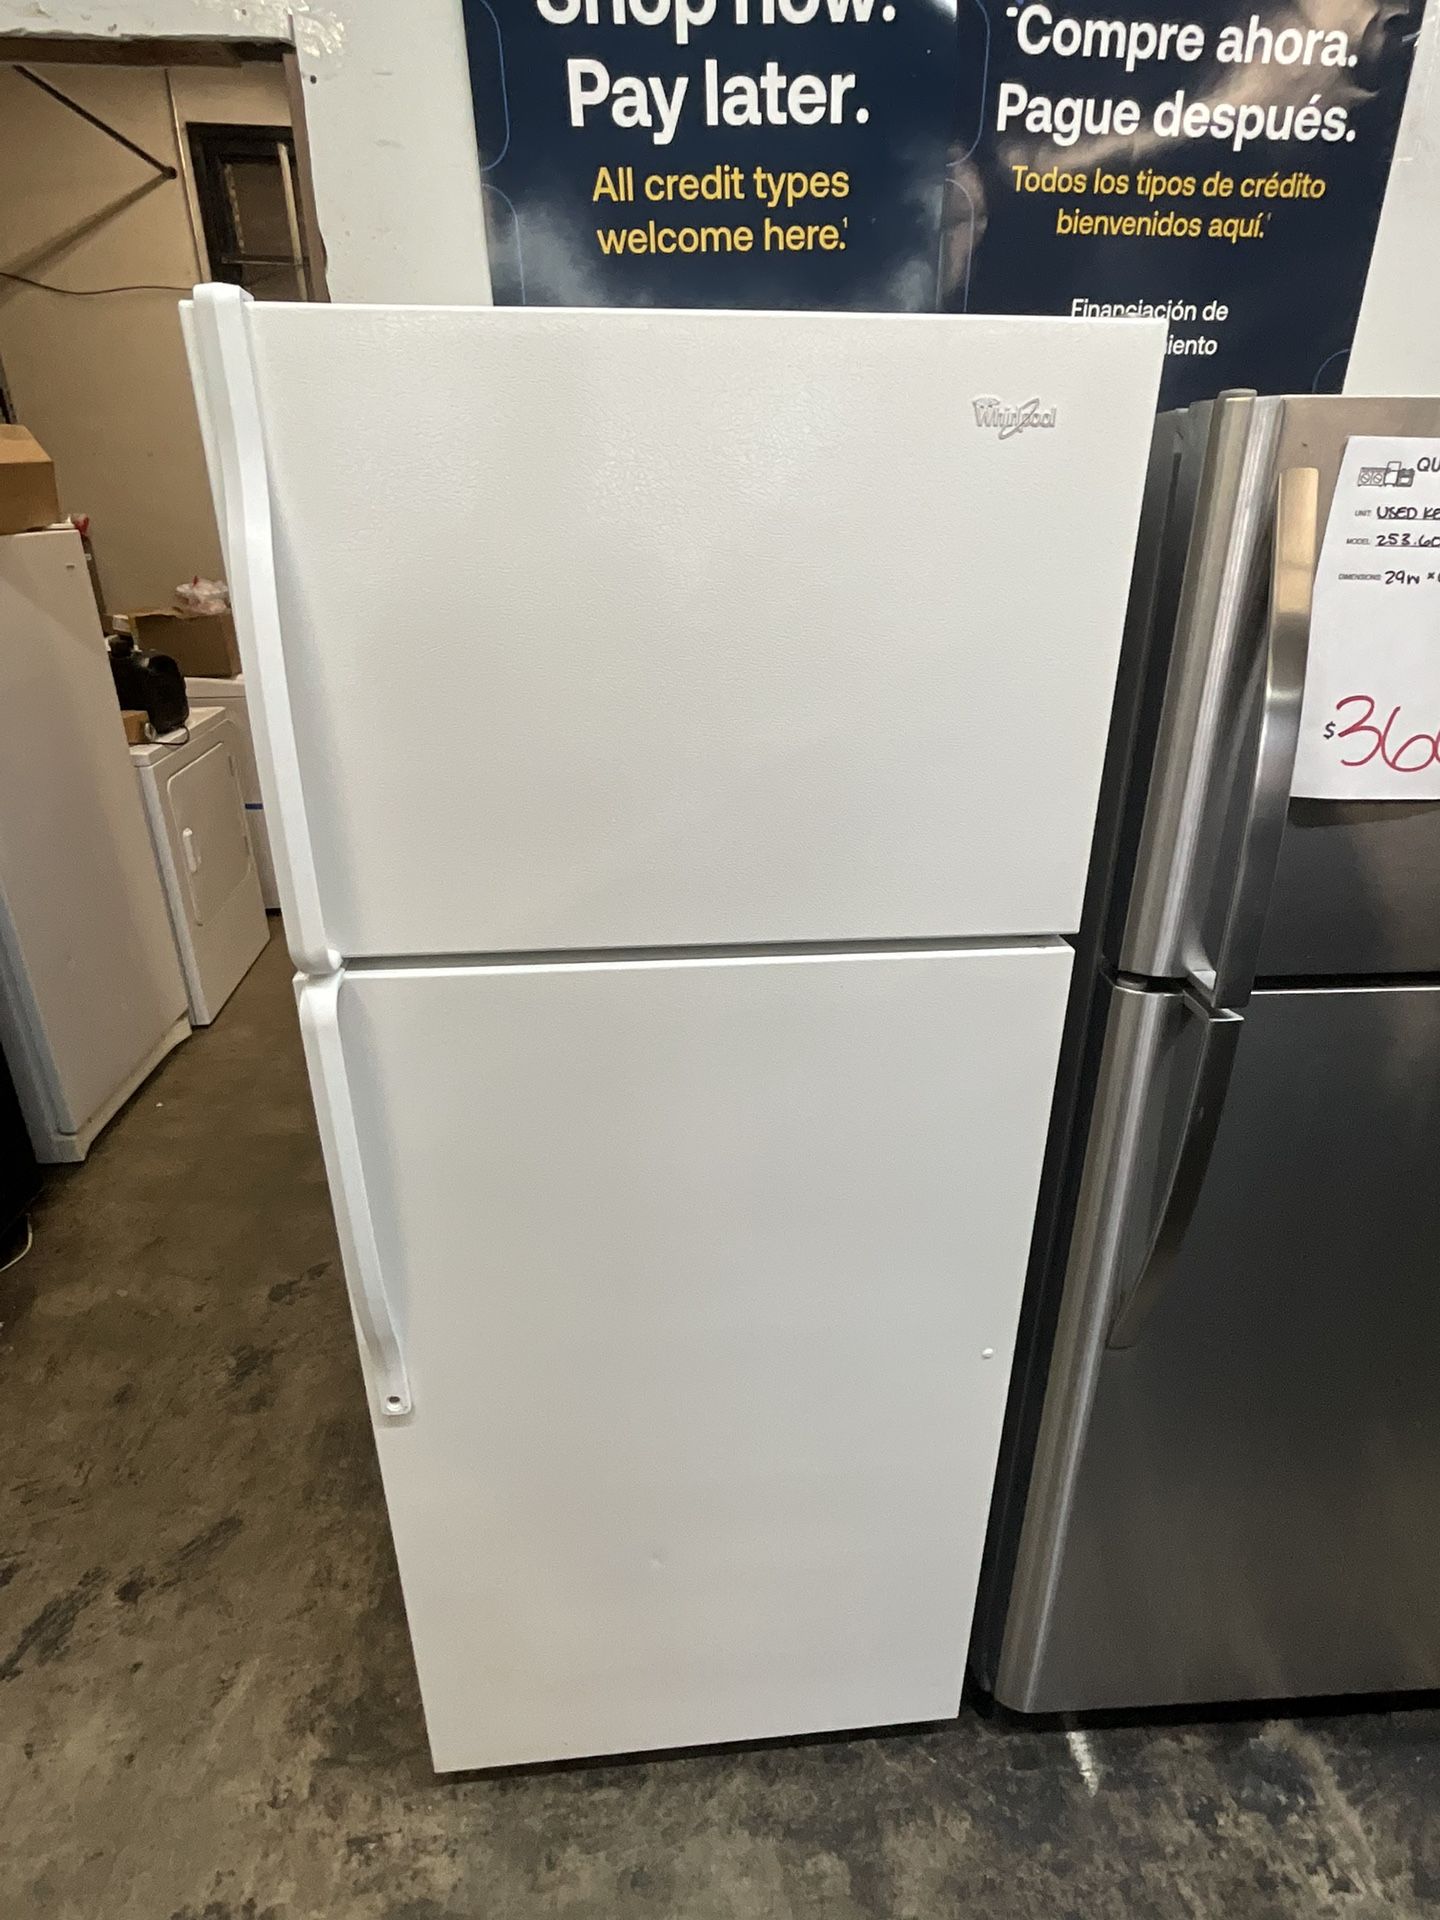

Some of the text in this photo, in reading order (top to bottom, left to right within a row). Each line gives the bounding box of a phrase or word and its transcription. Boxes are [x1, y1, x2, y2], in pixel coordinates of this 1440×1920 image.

[1017, 4, 1359, 72] Compre ahora.
[567, 58, 870, 145] Pay later.
[996, 82, 1356, 151] Pague después.
[593, 165, 850, 208] All credit types
[1011, 165, 1326, 202] Todos los tipos de crédito
[597, 220, 753, 254] welcome
[1057, 208, 1202, 238] bienvenidos
[1071, 298, 1229, 321] Financiación de
[1167, 334, 1218, 355] iento
[972, 396, 1057, 440] Whirlpool
[1417, 457, 1440, 473] QU
[1376, 506, 1418, 520] USED
[1322, 694, 1440, 773] $36
